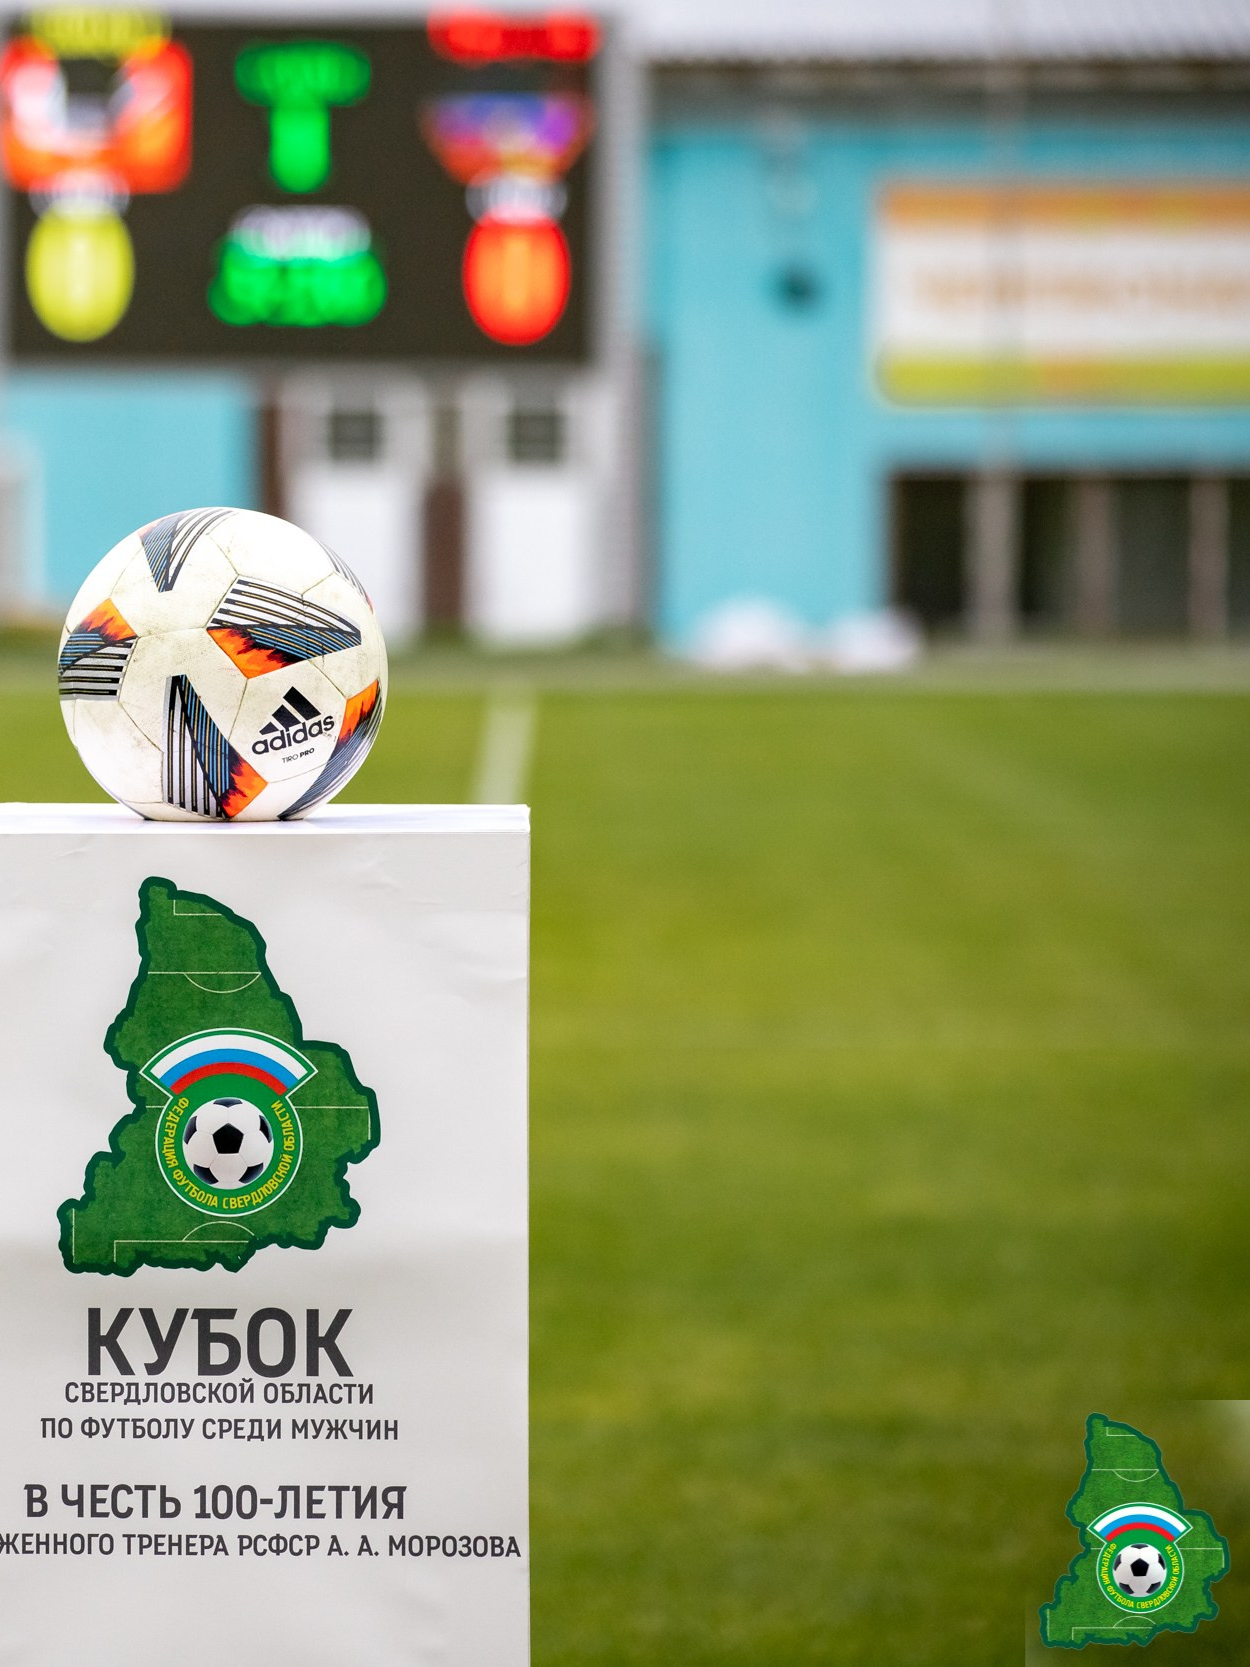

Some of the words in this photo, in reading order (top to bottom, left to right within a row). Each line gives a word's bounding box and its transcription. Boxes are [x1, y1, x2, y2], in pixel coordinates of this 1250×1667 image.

[252, 715, 335, 755] adidas
[281, 754, 299, 764] TIRO
[299, 747, 315, 758] PRO
[161, 1096, 190, 1169] ФЕДЕРАЦИЯ
[270, 1099, 296, 1152] ОБЛАСТИ
[172, 1169, 219, 1208] ФУТБОЛА
[222, 1155, 294, 1209] СВЕРДЛОВСКОЙ
[88, 1307, 354, 1377] КУБОК
[65, 1378, 255, 1405] СВЕРДЛОВСКОЙ
[263, 1382, 374, 1405] ОБЛАСТИ
[40, 1417, 73, 1440] ПО
[80, 1416, 195, 1440] ФУТБОЛУ
[202, 1418, 282, 1442] СРЕДИ
[291, 1418, 399, 1441] МУЖЧИН
[23, 1483, 49, 1518] В
[61, 1483, 182, 1519] ЧЕСТЬ
[193, 1484, 408, 1520] 100-ЛЕТИЯ
[122, 1533, 230, 1556] ТРЕНЕРА
[237, 1533, 320, 1557] РСФСР
[327, 1534, 350, 1557] А.
[357, 1534, 380, 1557] А.
[388, 1534, 522, 1558] МОРОЗОВА
